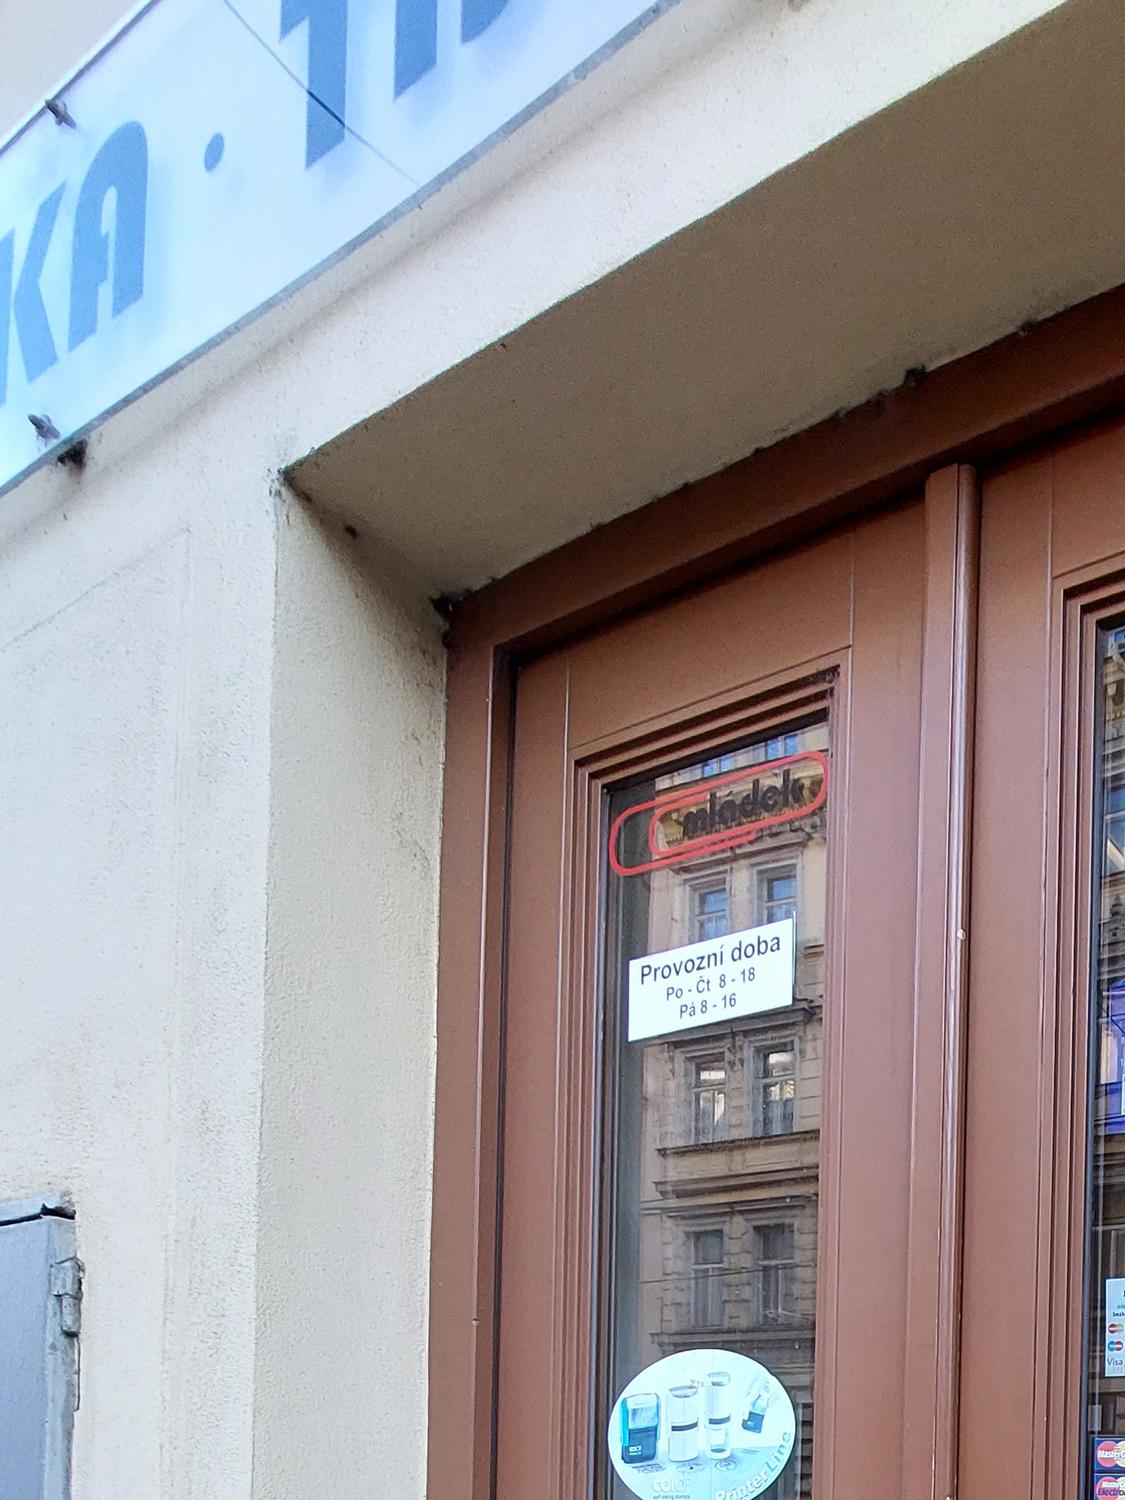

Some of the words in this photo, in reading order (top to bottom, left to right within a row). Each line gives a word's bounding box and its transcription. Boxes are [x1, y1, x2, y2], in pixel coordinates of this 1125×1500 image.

[640, 945, 724, 985] Provozní
[731, 935, 781, 963] doba
[666, 985, 684, 1001] Po
[696, 976, 711, 998] Čt
[719, 971, 727, 988] 8
[740, 966, 756, 984] 18
[680, 1000, 696, 1019] Pá
[700, 997, 708, 1014] 8
[722, 993, 737, 1009] 16
[1108, 1357, 1124, 1366] Visa
